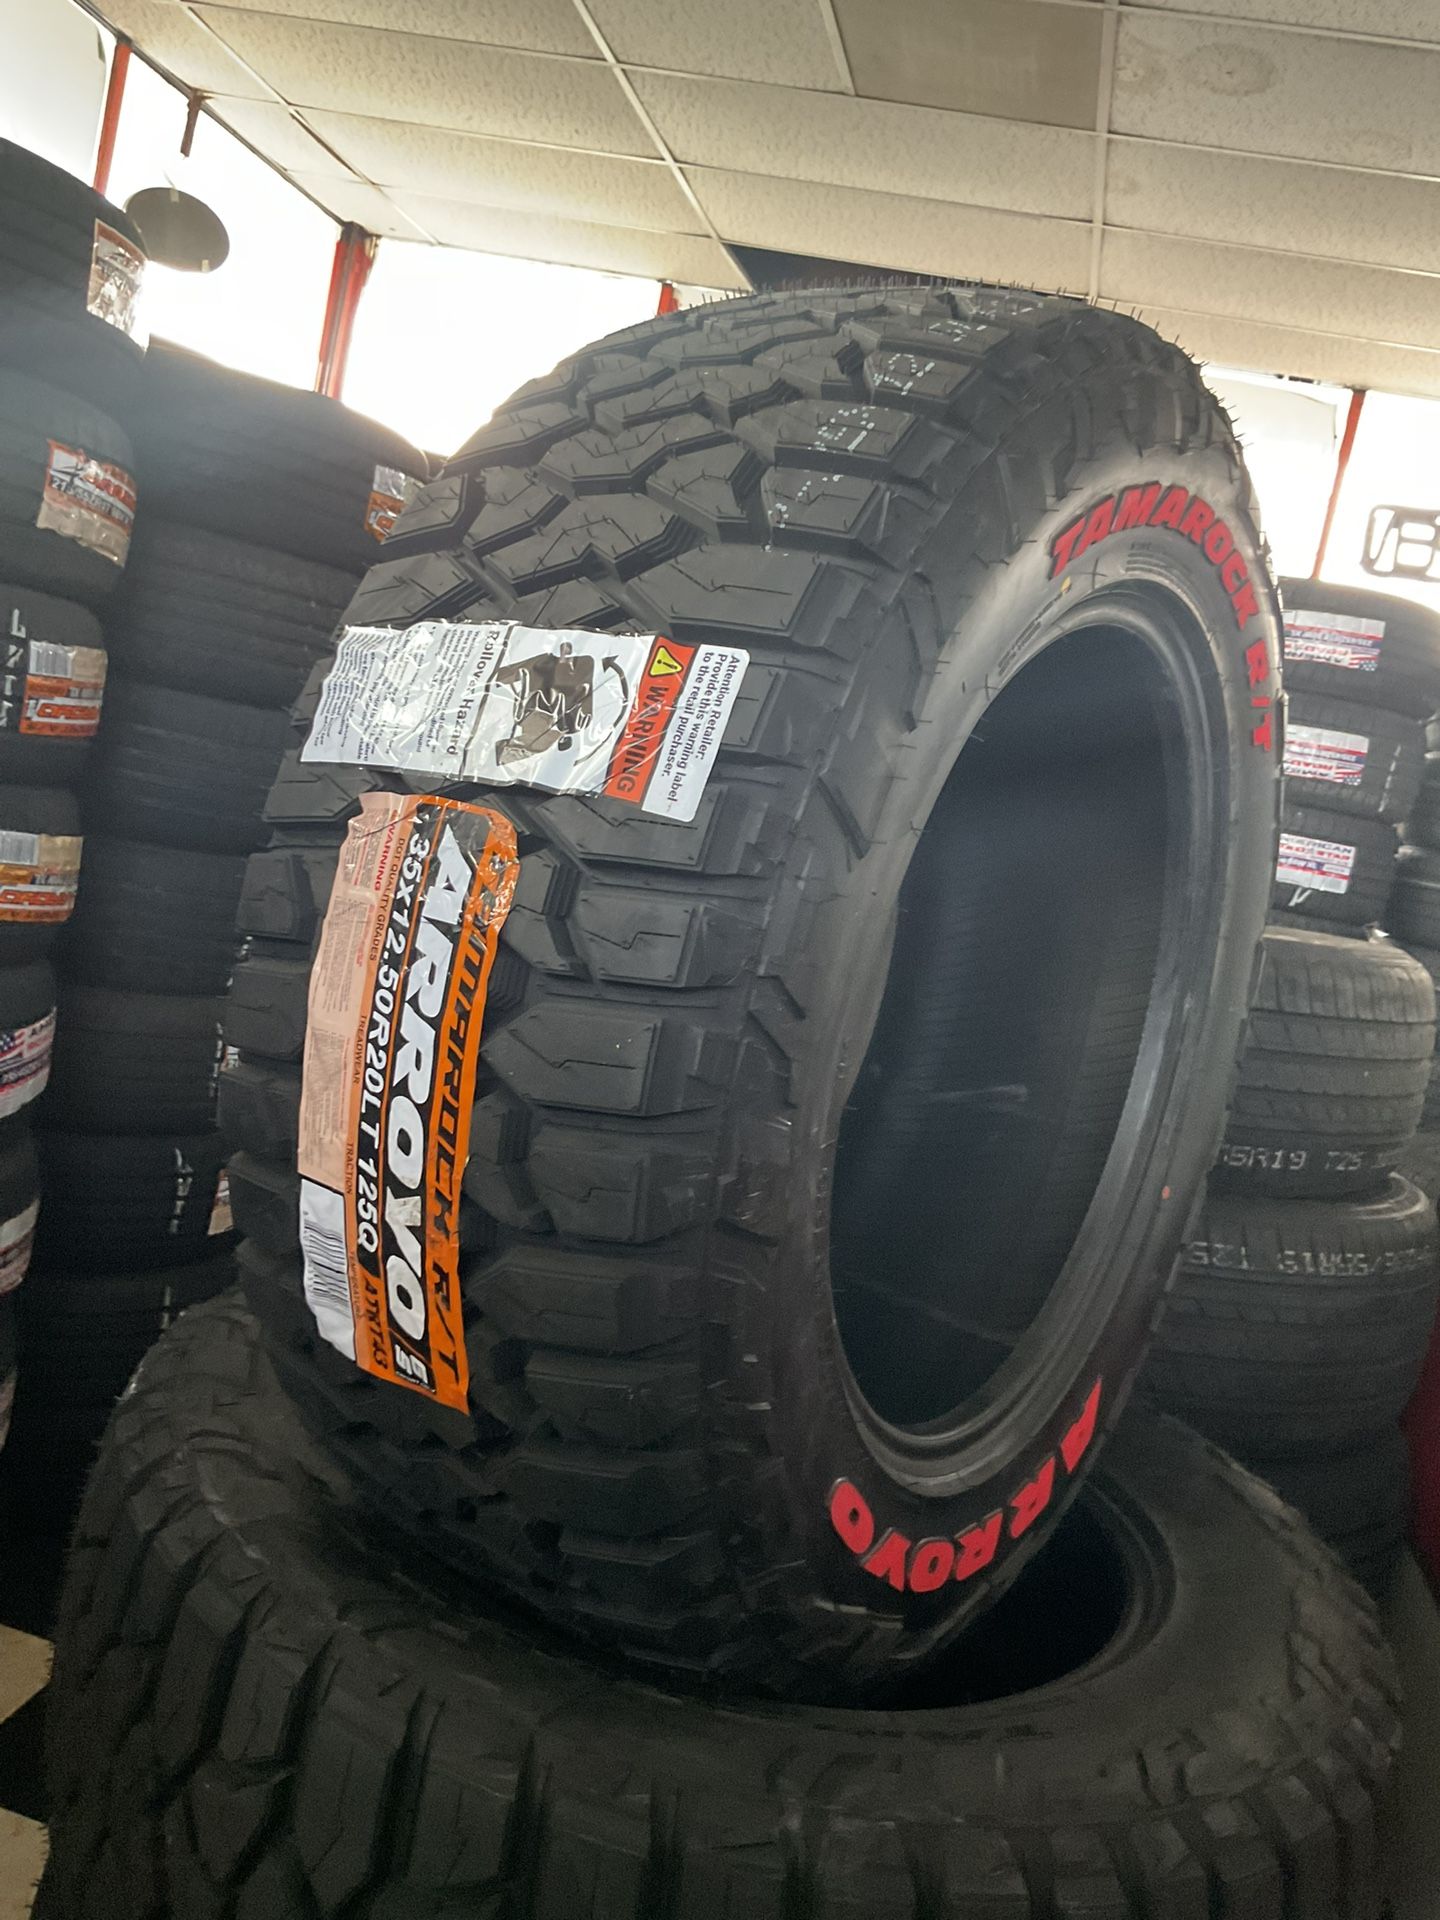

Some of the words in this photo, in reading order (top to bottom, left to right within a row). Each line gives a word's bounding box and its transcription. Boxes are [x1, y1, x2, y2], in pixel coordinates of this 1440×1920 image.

[1050, 481, 1259, 630] TAMAROCK
[466, 630, 500, 694] Rollover
[694, 664, 709, 684] the
[702, 651, 714, 664] to
[703, 654, 727, 701] Provide
[714, 656, 740, 707] Attention
[683, 686, 701, 715] retail
[696, 698, 710, 720] this
[445, 698, 473, 756] Hazard
[616, 685, 669, 794] WARNING
[662, 717, 689, 777] purchaser.
[676, 723, 701, 769] warning
[696, 710, 721, 760] Retailer:
[667, 772, 685, 802] label
[374, 824, 397, 891] WARNING
[393, 839, 405, 861] DOT
[379, 864, 399, 912] QUALITY
[369, 916, 386, 961] GRADES
[353, 1015, 367, 1084] TREADWEAR
[385, 824, 473, 1341] ARROYO
[346, 1143, 354, 1195] TRACTION
[357, 1157, 380, 1253] 125Q
[433, 1261, 460, 1385] R/T
[828, 1376, 1102, 1593] ARROYO
